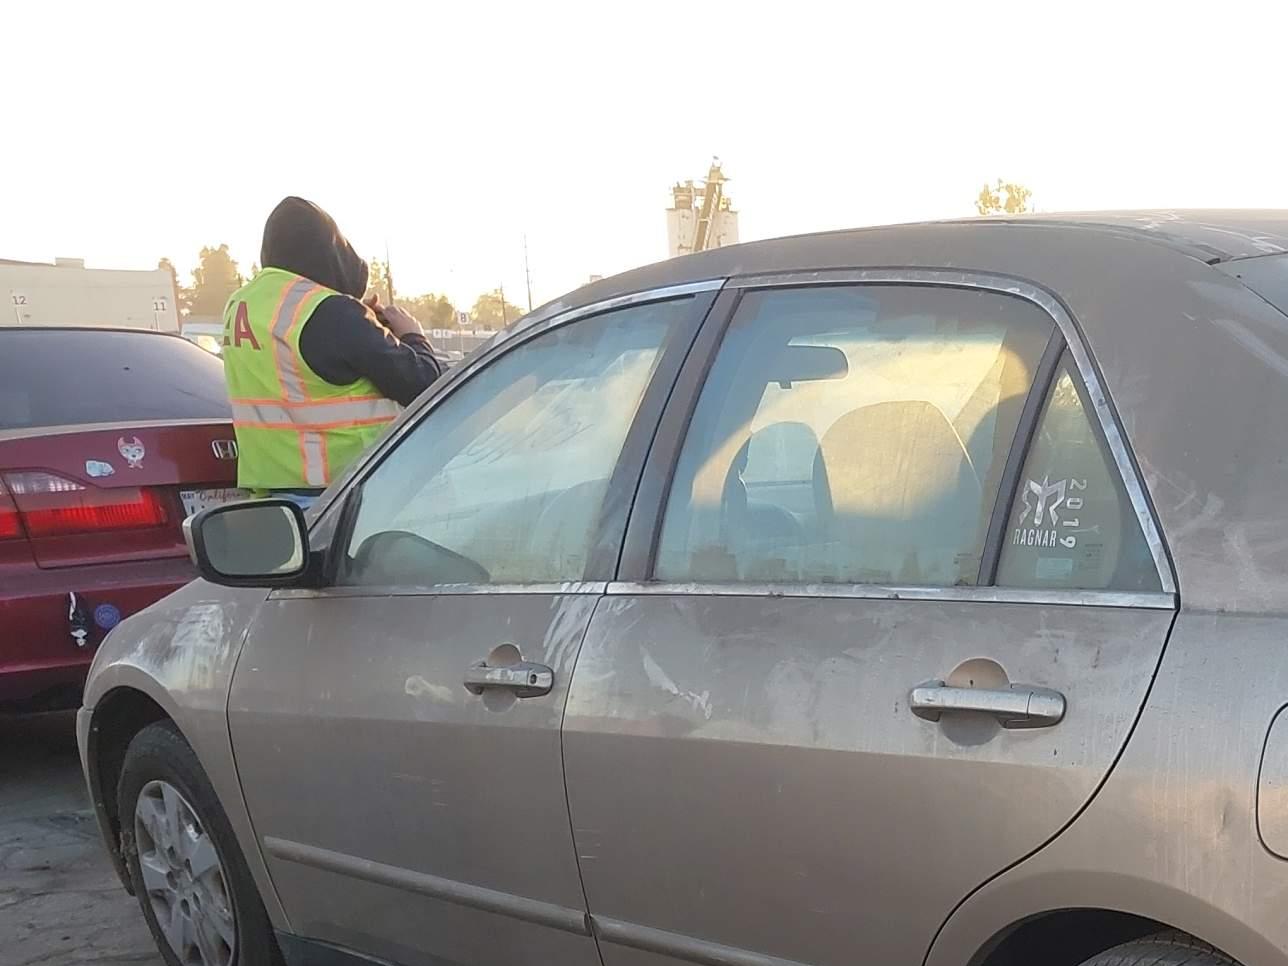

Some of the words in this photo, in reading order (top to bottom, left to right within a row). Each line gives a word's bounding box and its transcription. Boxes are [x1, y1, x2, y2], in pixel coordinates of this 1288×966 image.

[12, 295, 28, 305] 12
[153, 302, 167, 311] 11
[1060, 478, 1087, 548] 2019
[1012, 528, 1057, 547] RAGNAR
